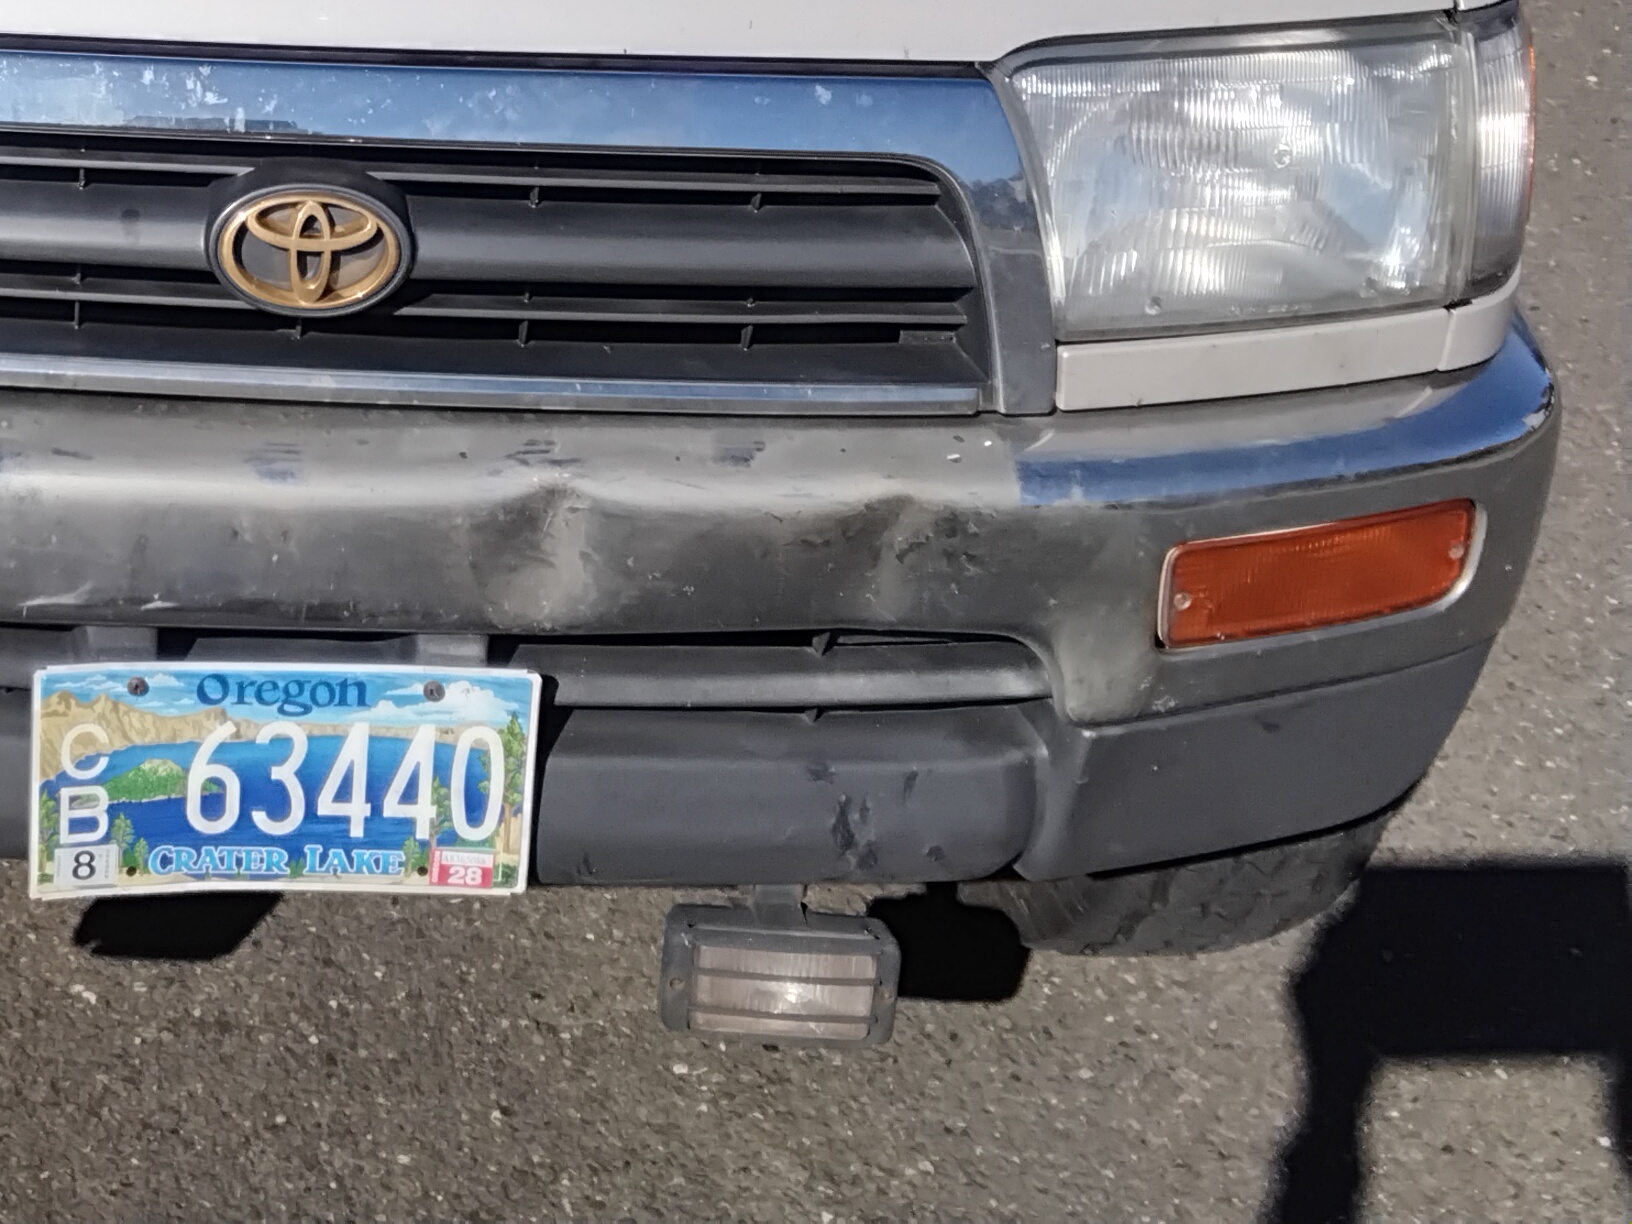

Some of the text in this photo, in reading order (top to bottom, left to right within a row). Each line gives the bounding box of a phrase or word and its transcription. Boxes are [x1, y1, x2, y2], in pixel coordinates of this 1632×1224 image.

[196, 672, 369, 717] Oregon
[185, 720, 505, 842] 63440
[72, 850, 97, 880] 8
[148, 844, 290, 876] CRATER
[303, 844, 406, 876] LAKE
[447, 865, 483, 885] 28
